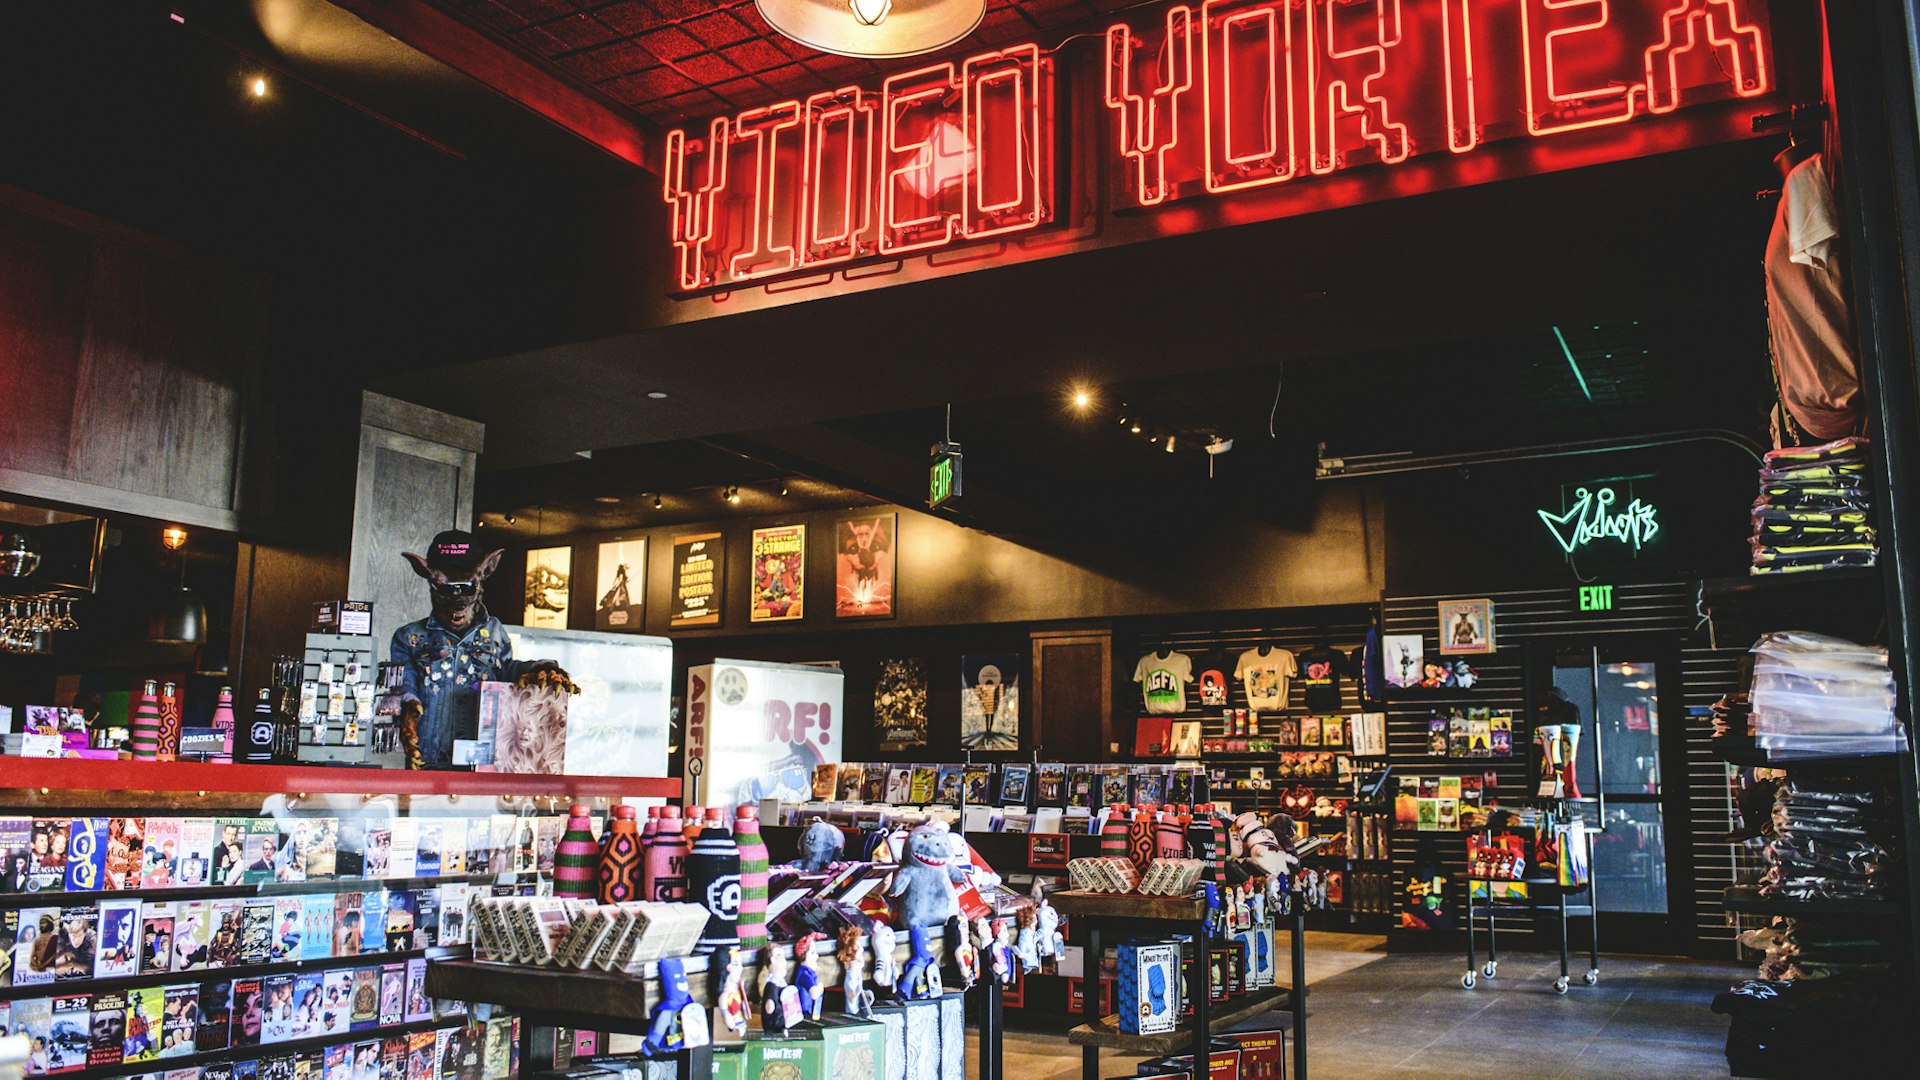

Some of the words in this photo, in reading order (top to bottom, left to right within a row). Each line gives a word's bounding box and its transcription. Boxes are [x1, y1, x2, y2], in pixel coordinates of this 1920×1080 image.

[663, 42, 1041, 291] VIDEO
[1105, 0, 1768, 205] VORTEX
[933, 458, 950, 502] EXIT
[763, 540, 801, 555] STRANGE
[680, 559, 714, 574] LIMITED
[680, 571, 713, 586] EDITION
[679, 583, 714, 599] POSTERS
[1579, 585, 1613, 611] EXIT
[344, 603, 369, 611] PRIDE
[1146, 670, 1178, 692] AGFA
[763, 699, 832, 746] RF!
[182, 734, 214, 744] COOZIES
[30, 865, 65, 874] REAGANS
[55, 997, 88, 1009] B-29
[94, 1001, 125, 1011] PASOLINI
[380, 1014, 401, 1025] NOVA
